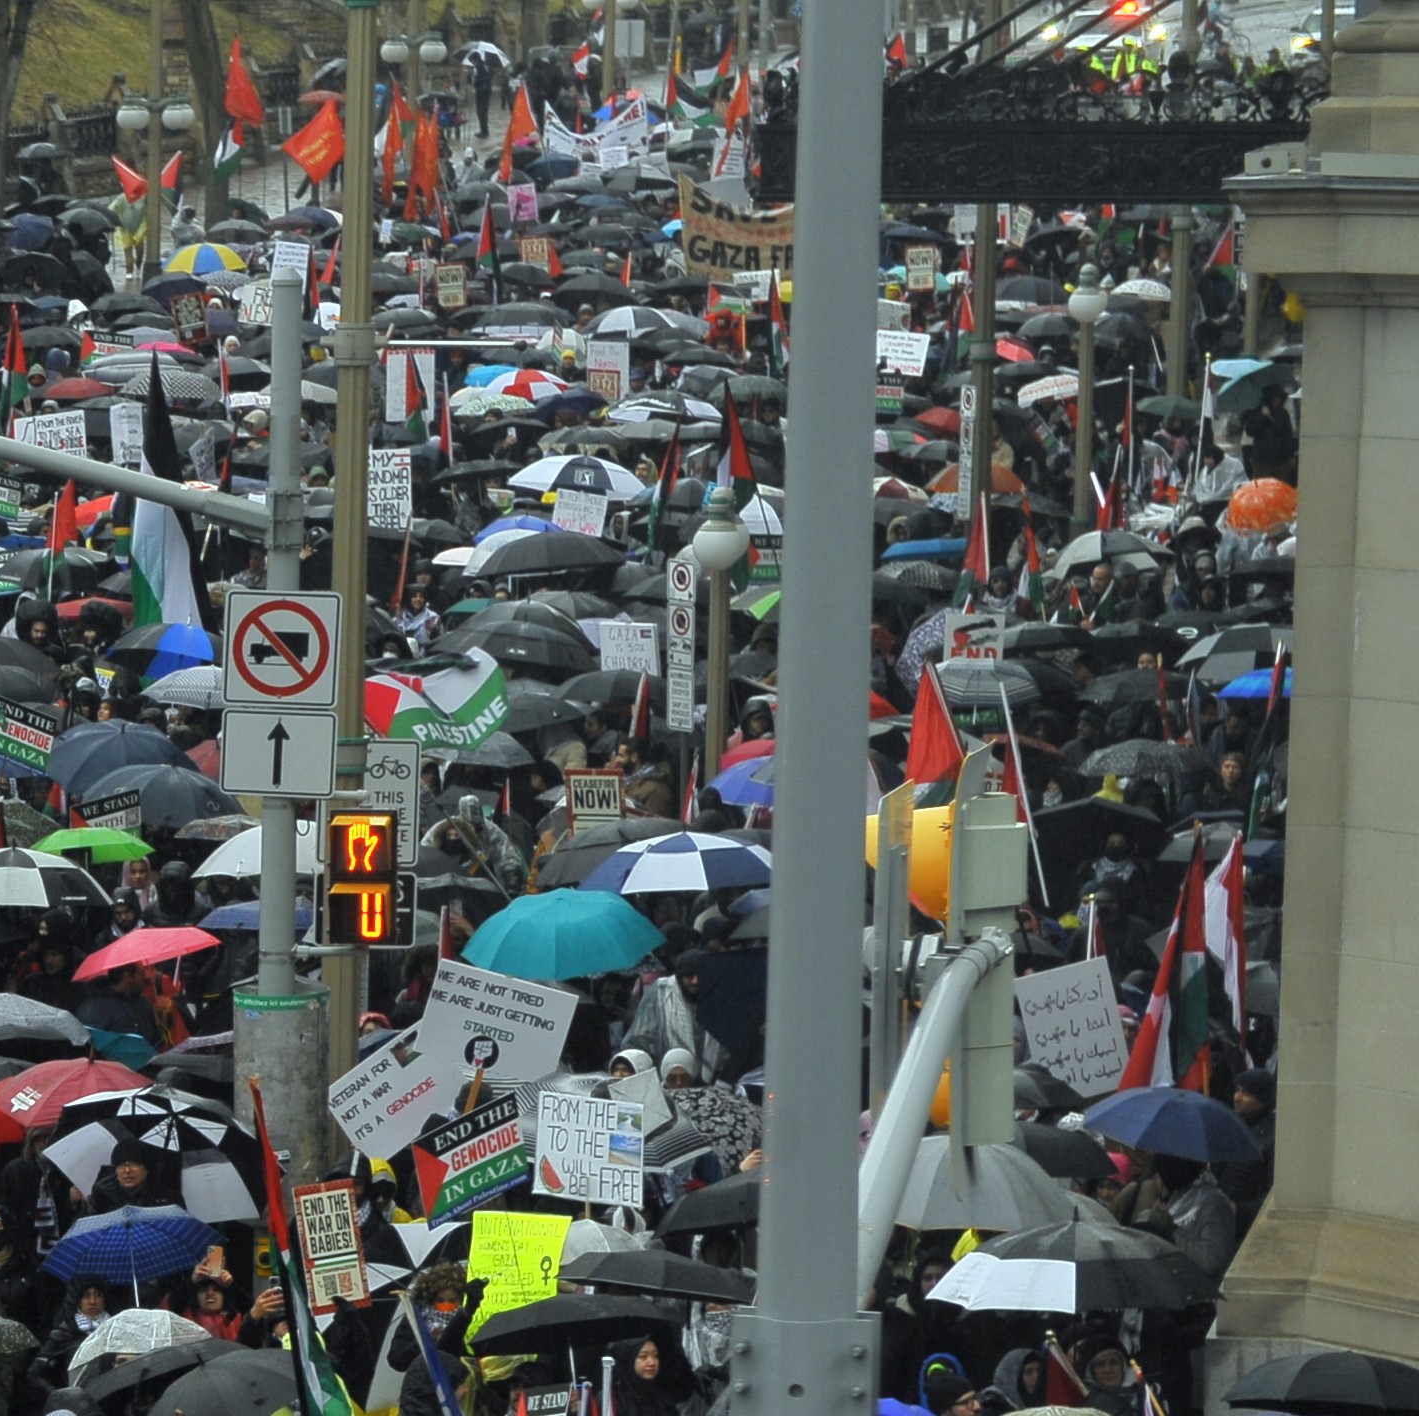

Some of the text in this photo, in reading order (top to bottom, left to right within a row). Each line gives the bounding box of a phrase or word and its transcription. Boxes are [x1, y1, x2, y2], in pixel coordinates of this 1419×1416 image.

[686, 234, 760, 270] GAZA
[371, 451, 393, 468] MY
[378, 486, 409, 502] OLDER
[372, 502, 401, 517] THAN
[604, 655, 652, 671] CHILDREN
[27, 711, 54, 733] THE
[412, 694, 508, 745] PALESTINE
[7, 742, 46, 768] GAZA
[374, 790, 405, 805] THIS
[574, 788, 618, 810] NOW!
[437, 968, 545, 1009] WE ARE NOT TIRED
[430, 990, 555, 1033] WE ARE JUST GETTING
[462, 1018, 515, 1045] STARTED
[541, 1095, 618, 1131] FROM THE
[433, 1102, 518, 1151] END THE
[451, 1122, 520, 1172] GENOCIDE
[547, 1124, 606, 1159] TO THE
[443, 1155, 525, 1203] IN GAZA
[562, 1156, 597, 1178] WILL
[567, 1165, 640, 1205] BE FREE
[303, 1193, 350, 1218] END THE
[308, 1212, 354, 1237] WAR ON
[479, 1217, 562, 1237] INTERNATIONAL
[312, 1230, 357, 1256] BABIES!
